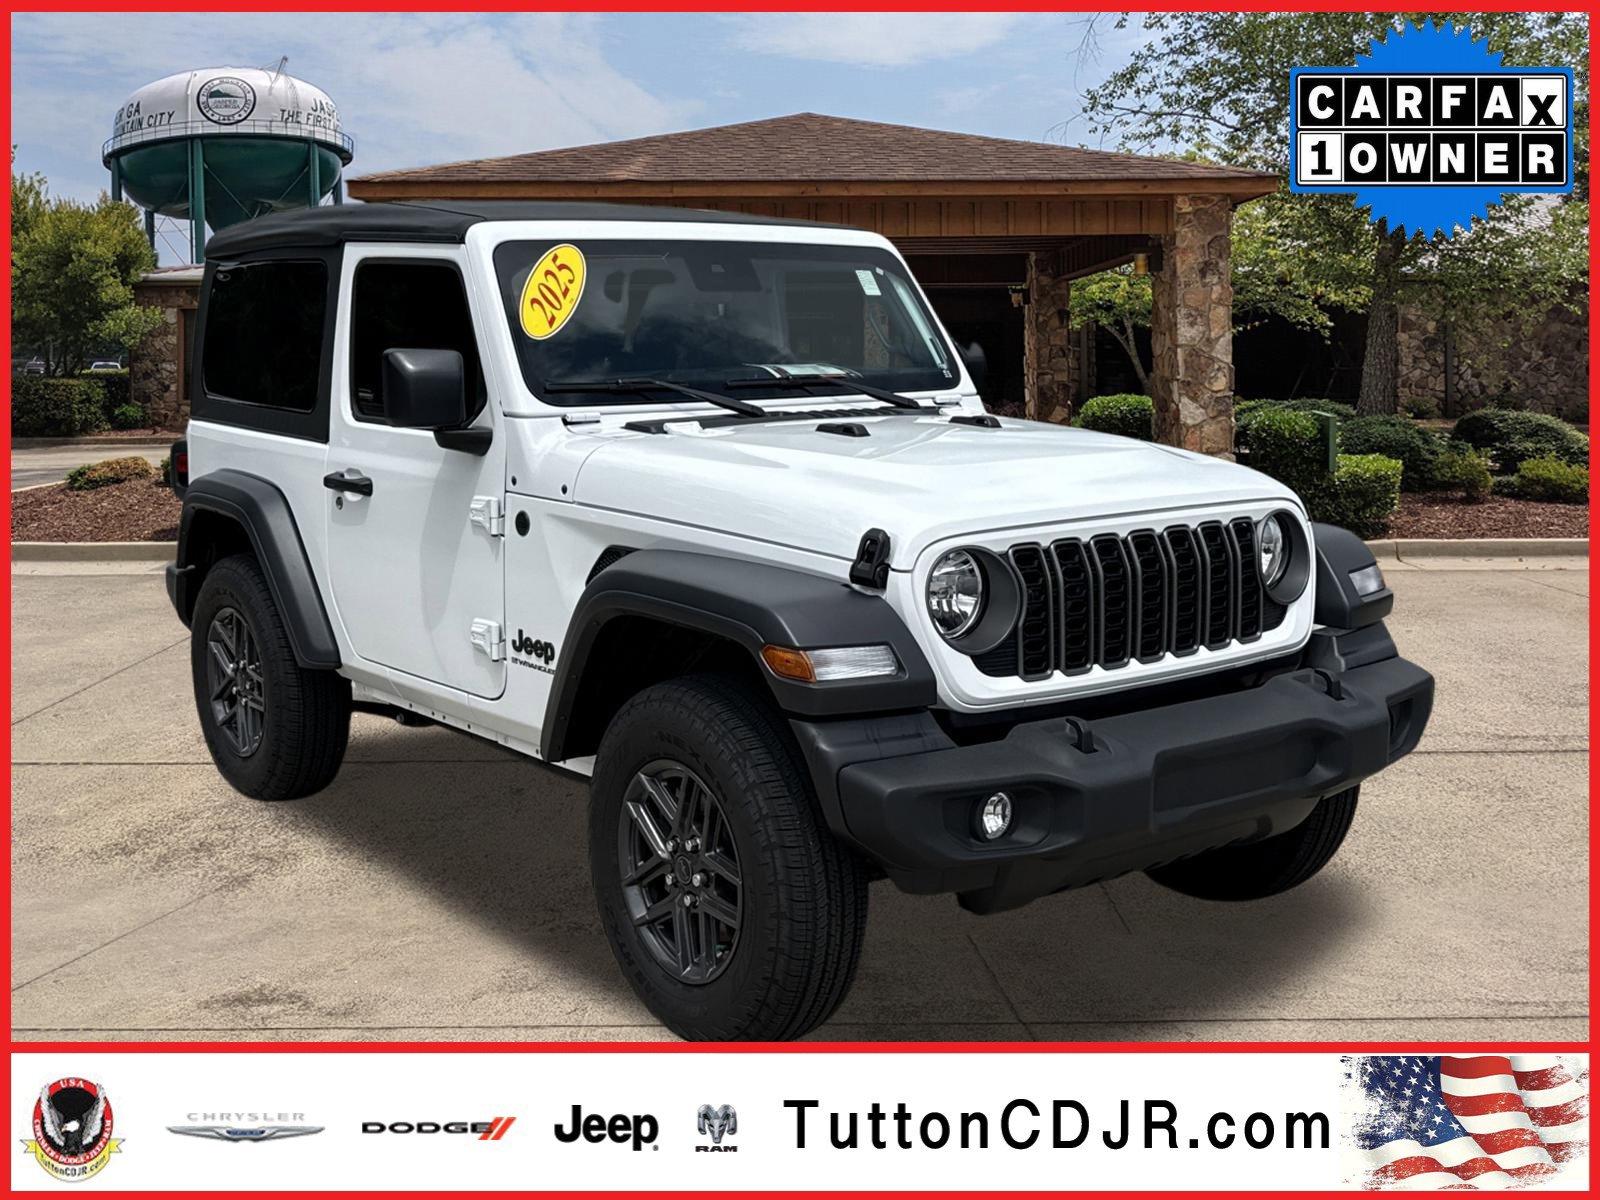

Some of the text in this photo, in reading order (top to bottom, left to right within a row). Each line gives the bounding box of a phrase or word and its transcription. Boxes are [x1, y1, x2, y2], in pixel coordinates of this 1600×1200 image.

[127, 101, 140, 119] GA
[147, 110, 175, 127] CITY
[280, 108, 302, 124] THE
[530, 253, 575, 328] 2025
[512, 629, 555, 665] Jeep
